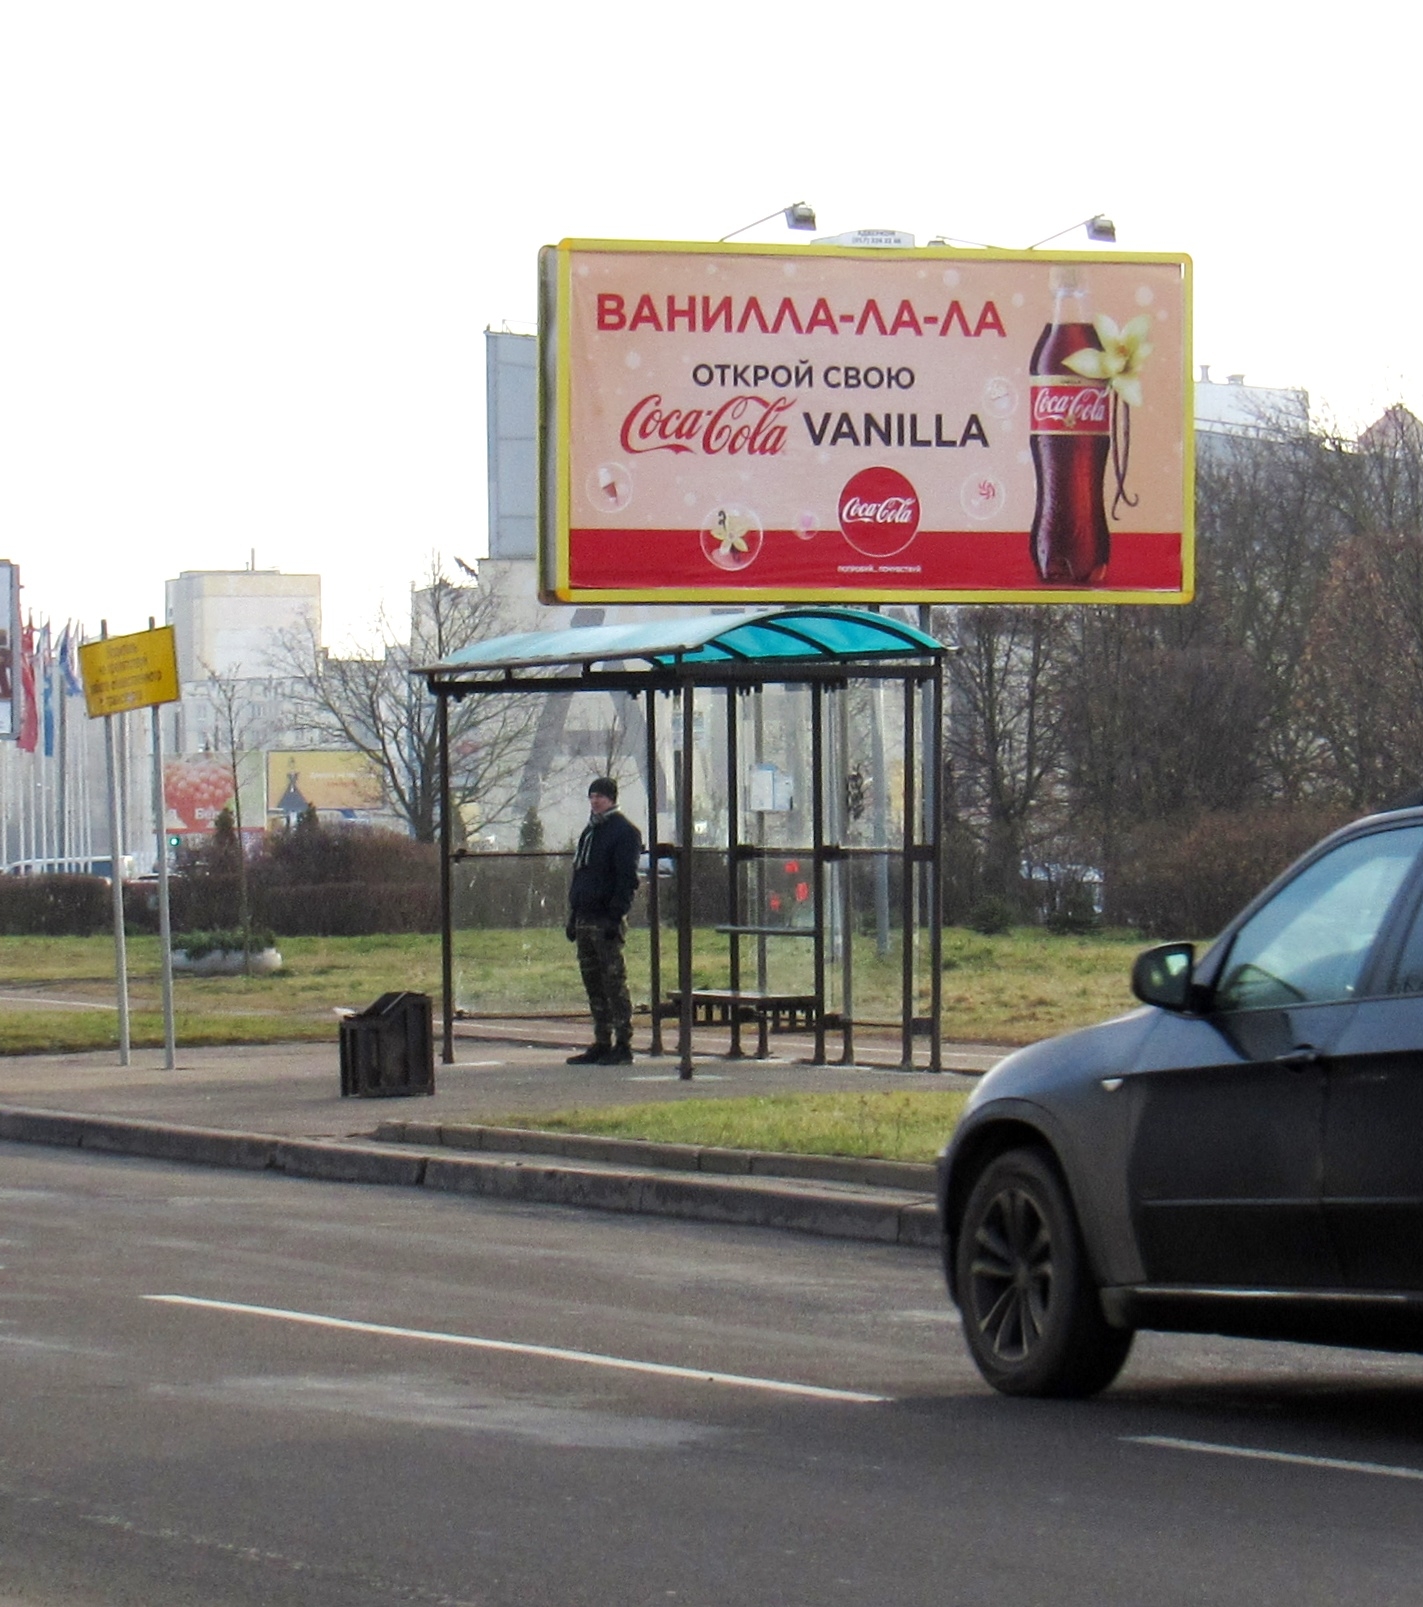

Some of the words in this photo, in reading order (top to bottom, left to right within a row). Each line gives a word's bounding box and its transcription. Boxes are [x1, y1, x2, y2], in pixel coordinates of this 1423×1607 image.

[597, 293, 1007, 337] ВАНИЛЛА-ЛА-ЛА
[692, 359, 814, 388] ОТКРОЙ
[823, 366, 915, 389] СВОЮ
[1034, 387, 1111, 421] Coca-Cola
[620, 394, 797, 455] Coca-Cola
[803, 412, 990, 447] VANILLA
[842, 497, 916, 523] Coca-Cola
